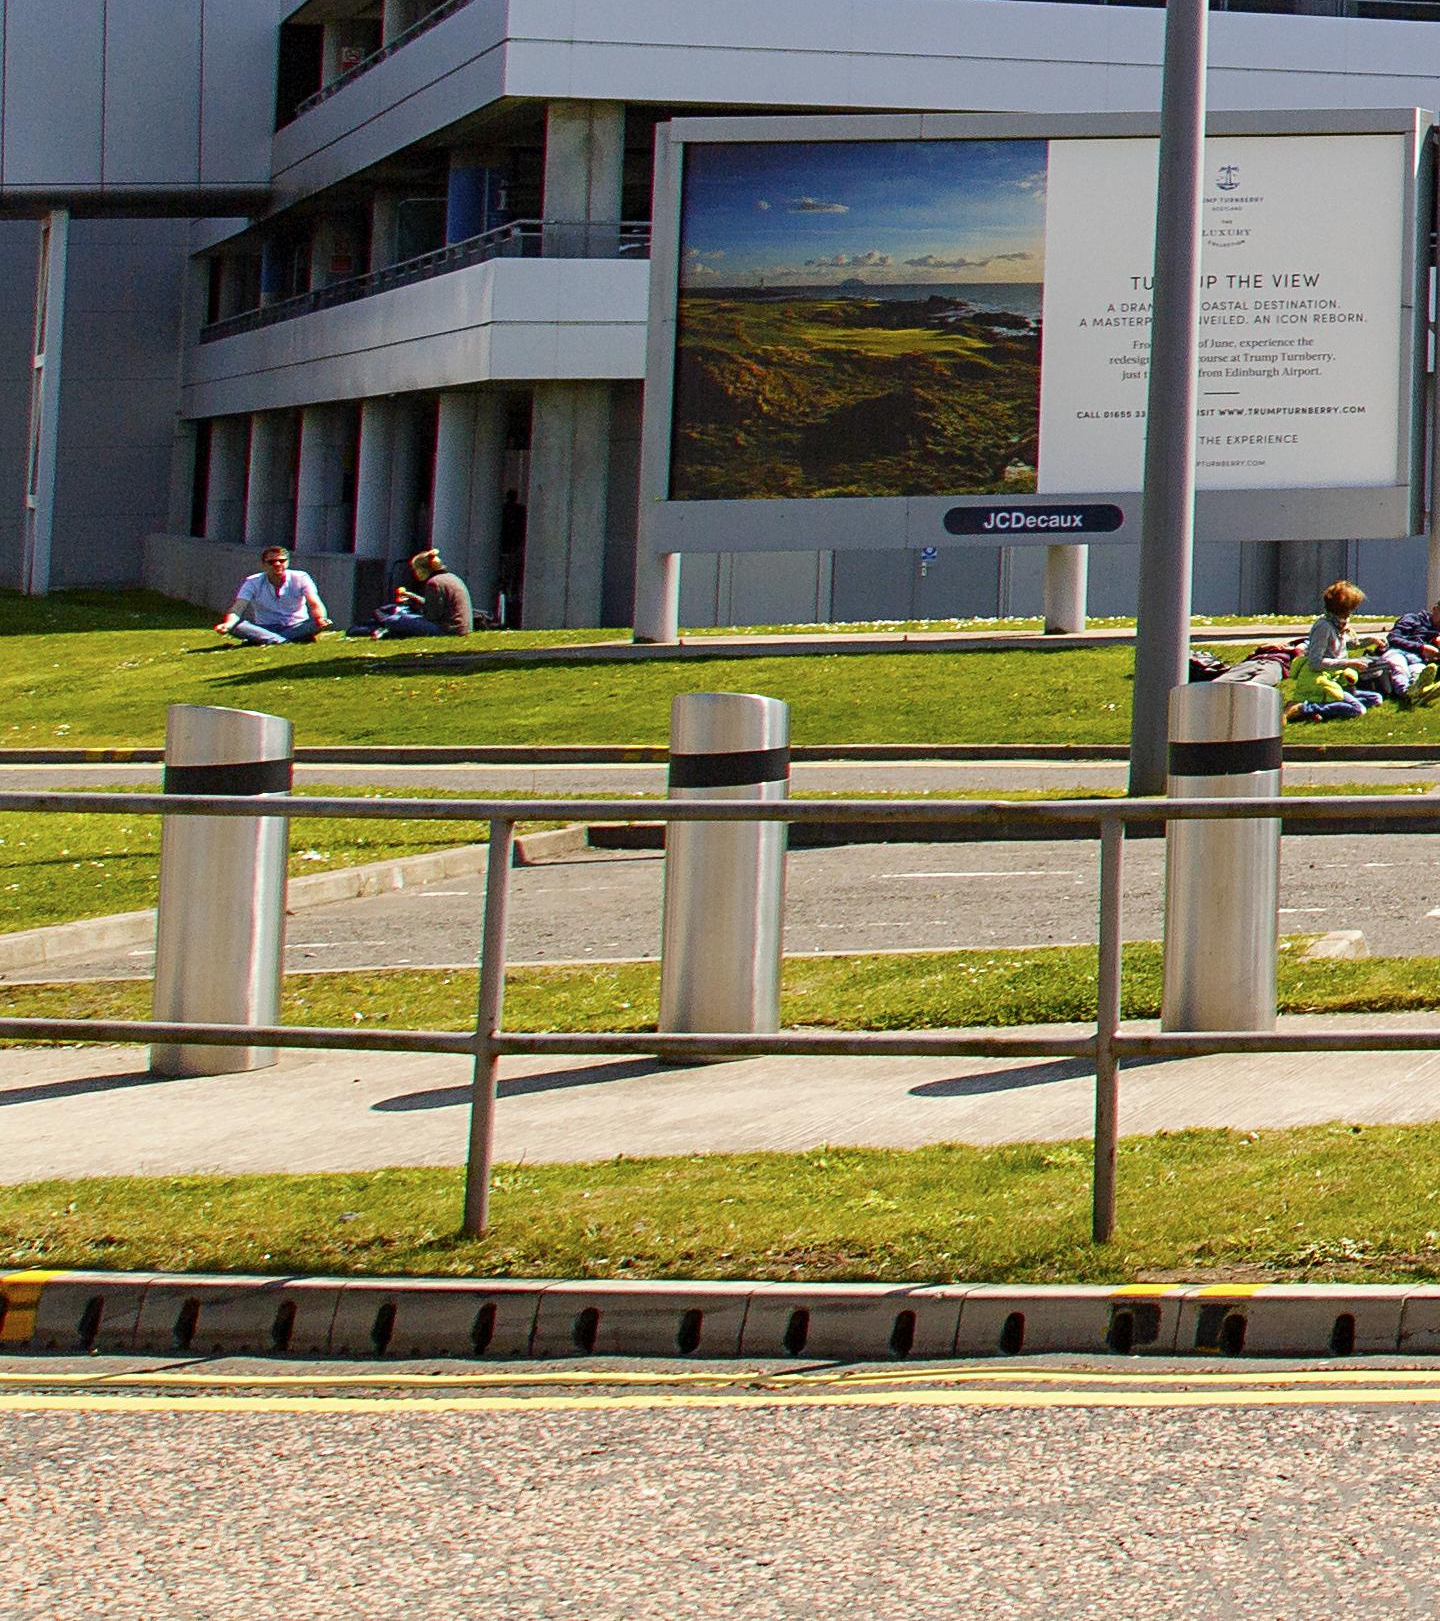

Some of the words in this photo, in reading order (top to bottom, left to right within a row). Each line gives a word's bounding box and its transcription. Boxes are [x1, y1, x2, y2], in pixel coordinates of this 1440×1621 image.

[1202, 229, 1251, 237] LUXURY
[1130, 276, 1154, 290] TU
[1226, 275, 1264, 288] THE
[1272, 273, 1320, 288] VIEW
[1107, 303, 1115, 312] A
[1201, 301, 1249, 311] OASTAL
[1254, 299, 1341, 310] DESTINATION.
[1080, 317, 1088, 327] A
[1254, 314, 1271, 324] AN
[1276, 313, 1309, 324] ICON
[1313, 312, 1367, 323] REBORN.
[1209, 338, 1236, 348] June,
[1239, 338, 1296, 348] experience
[1297, 337, 1314, 346] the
[1230, 354, 1241, 363] at
[1243, 353, 1278, 364] Trump
[1225, 366, 1279, 379] Edinburgh
[1281, 366, 1322, 378] Airport.
[1076, 411, 1101, 419] CALL
[1196, 408, 1215, 417] ISIT
[1218, 405, 1367, 416] WWW.TRUMPTURNBERRY.COM
[1200, 435, 1222, 445] THE
[1226, 434, 1299, 445] EXPERIENCE
[984, 512, 1083, 529] JCDecaux
